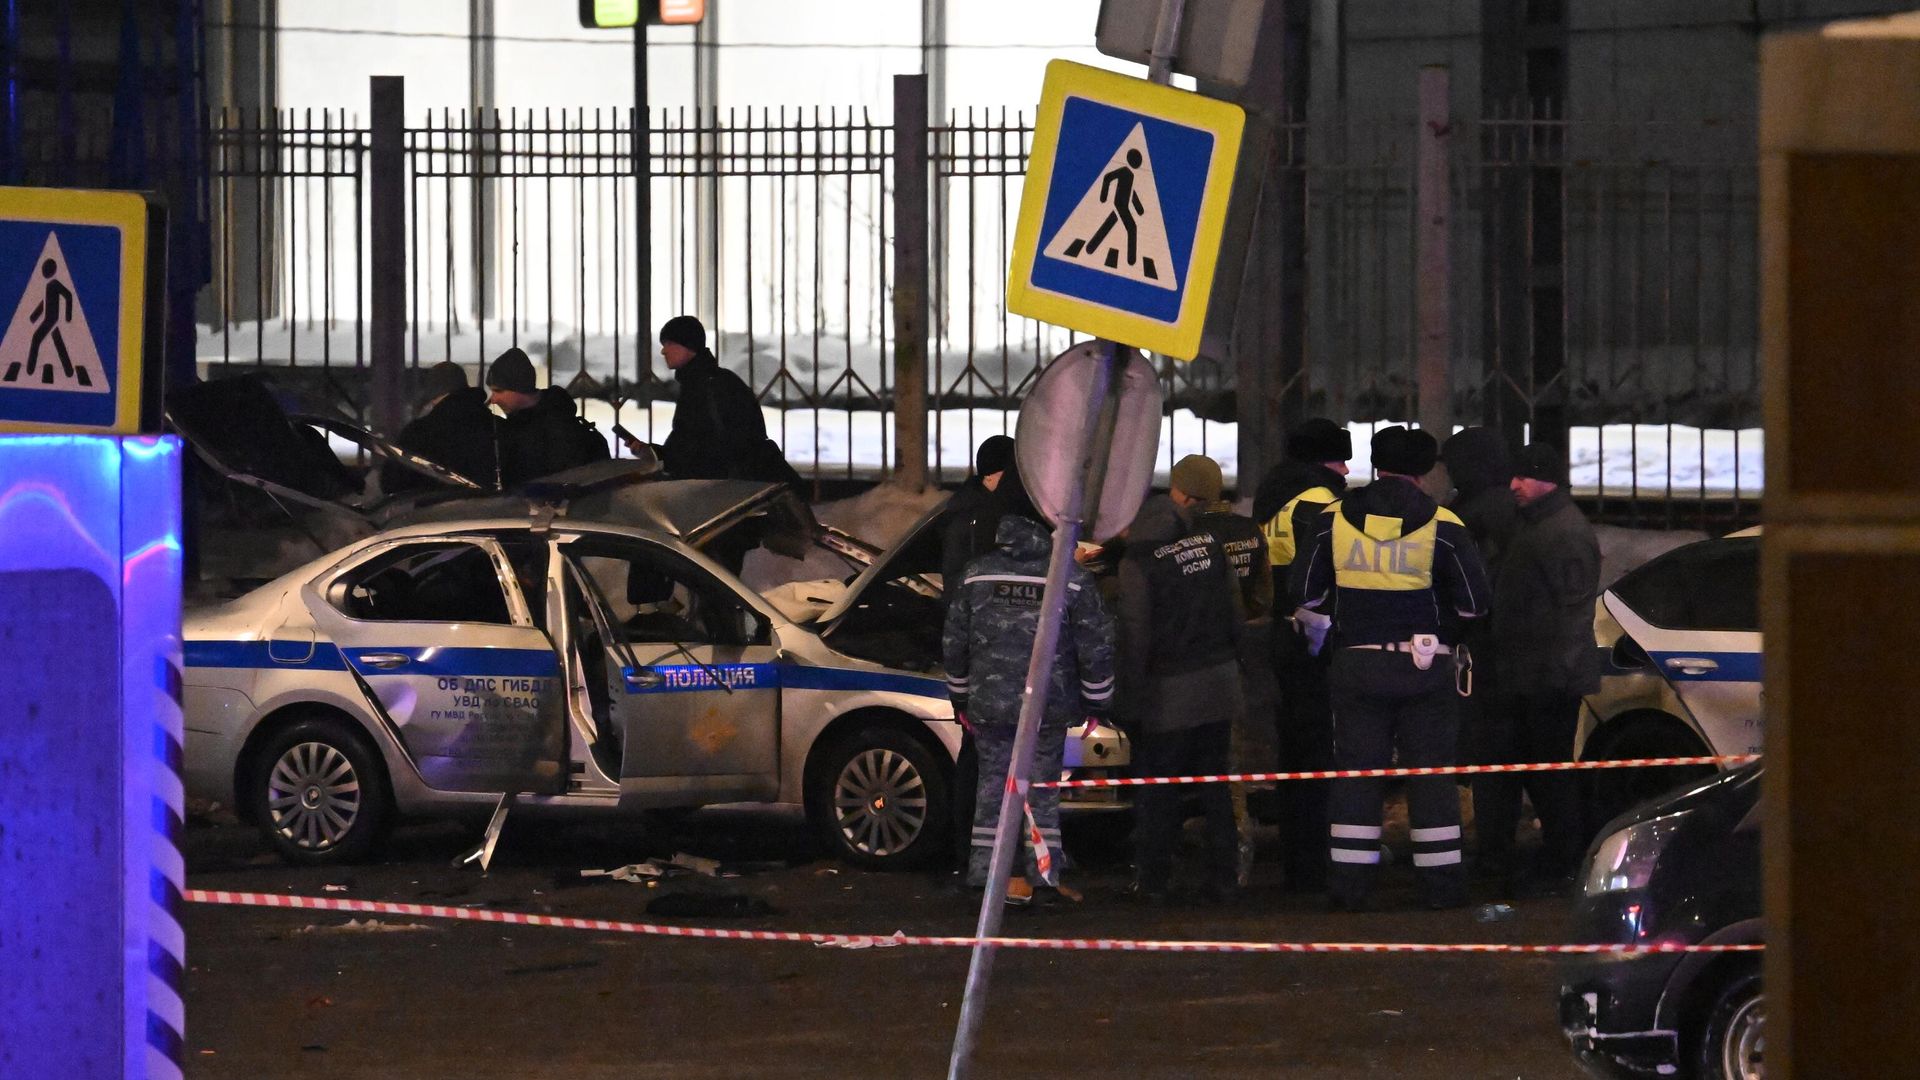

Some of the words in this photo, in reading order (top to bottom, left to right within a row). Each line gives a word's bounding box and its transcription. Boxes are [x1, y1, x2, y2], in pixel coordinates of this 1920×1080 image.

[1342, 538, 1423, 576] ДПС
[999, 584, 1037, 599] ЭКЦ
[664, 666, 755, 689] ПОЛИЦИЯ
[438, 678, 458, 691] ОБ
[464, 679, 496, 693] ДПС
[453, 695, 480, 708] УВД
[503, 697, 540, 709] СВАО
[444, 711, 465, 720] МВД
